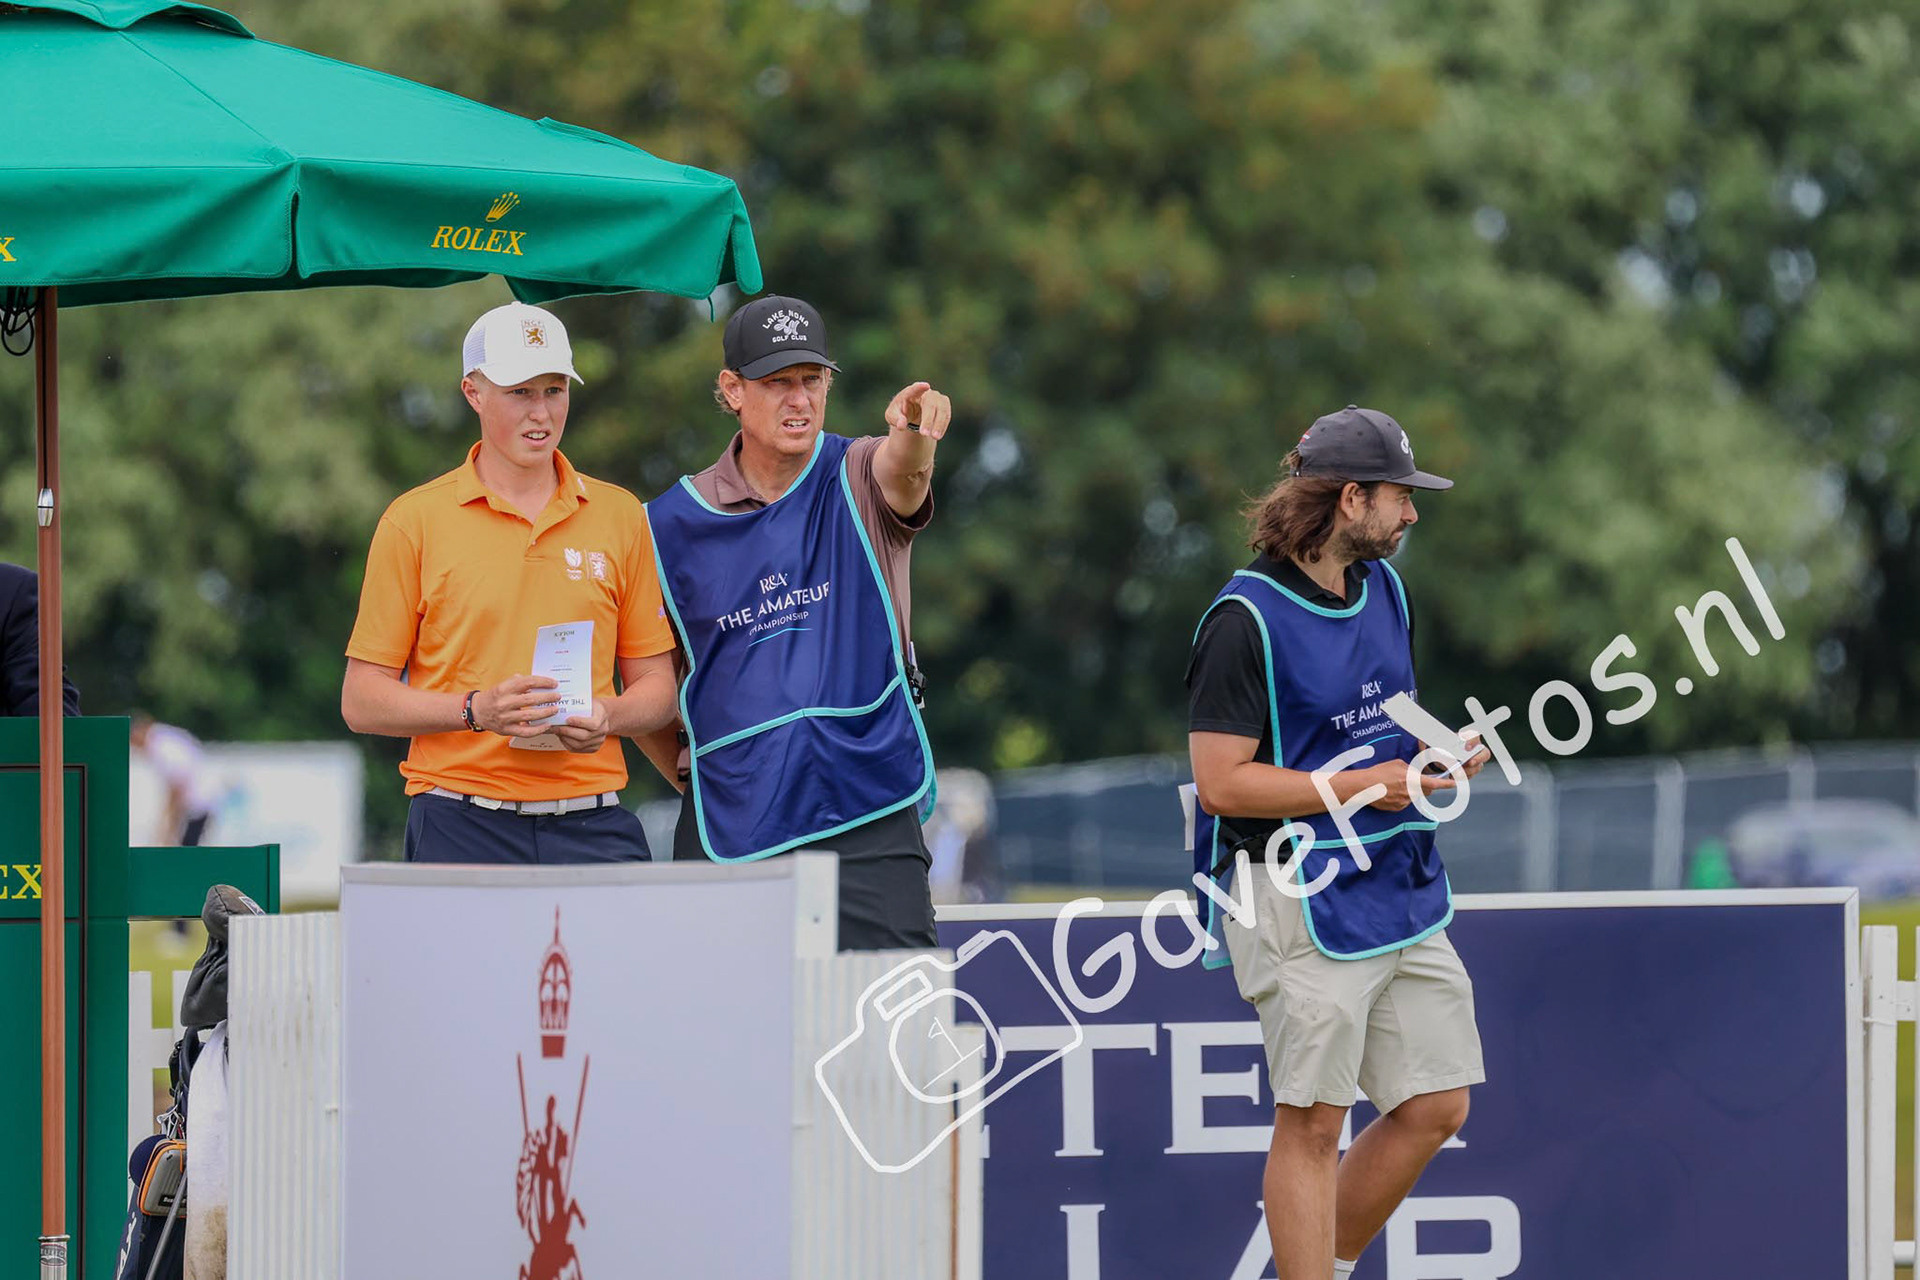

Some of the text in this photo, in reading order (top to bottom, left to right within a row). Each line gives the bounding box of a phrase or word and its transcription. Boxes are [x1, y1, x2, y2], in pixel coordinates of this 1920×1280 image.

[430, 225, 527, 256] ROLEX
[762, 309, 809, 329] LAKE NONA
[772, 334, 788, 343] GOLF
[759, 572, 788, 594] R&A
[716, 607, 754, 632] THE
[1361, 680, 1382, 699] R&A
[1331, 709, 1356, 730] THE
[0, 864, 42, 899] X
